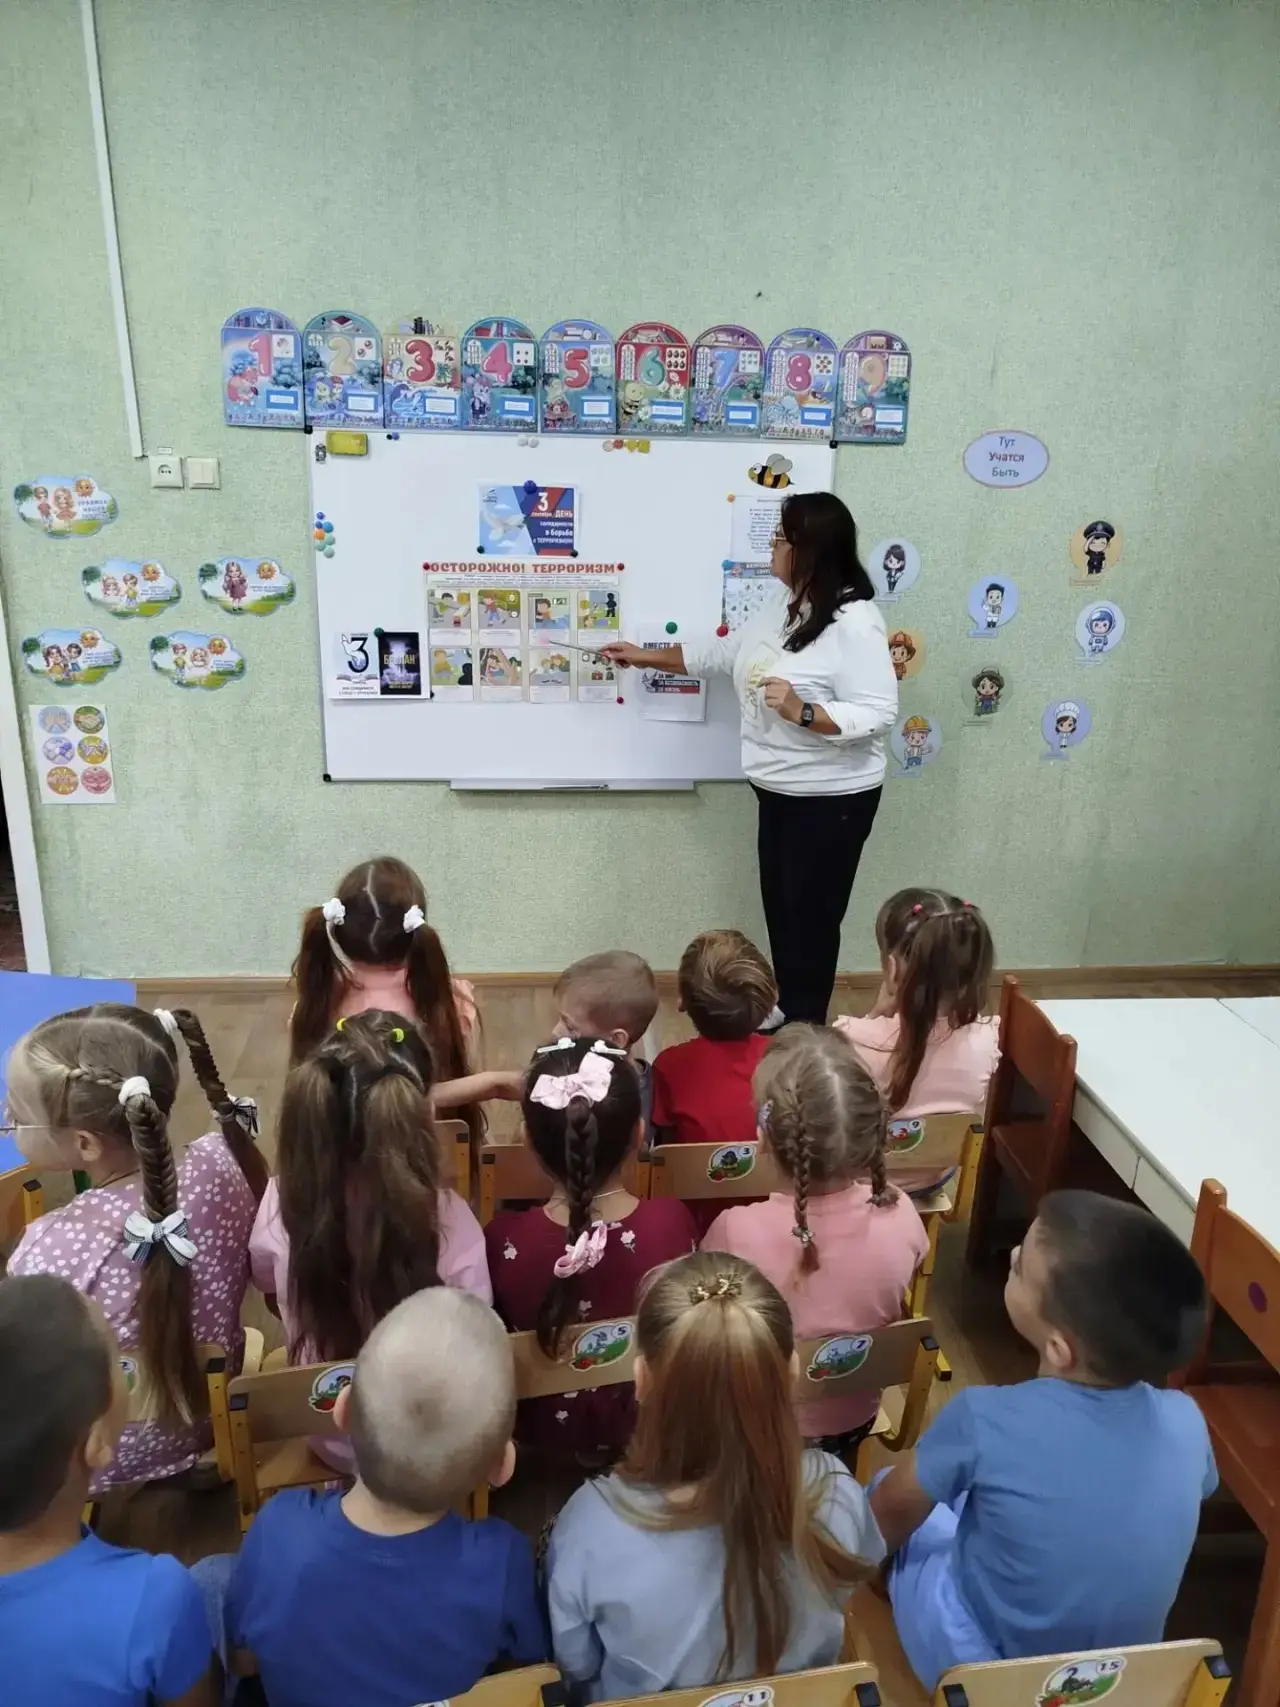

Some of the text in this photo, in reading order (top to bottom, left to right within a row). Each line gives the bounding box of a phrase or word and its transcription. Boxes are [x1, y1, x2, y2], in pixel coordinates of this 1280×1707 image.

[248, 332, 272, 377] 1
[327, 334, 356, 376] 2
[405, 339, 435, 382] 3
[480, 340, 513, 385] 4
[563, 347, 591, 390] 5
[639, 346, 666, 387] 6
[713, 348, 738, 390] 7
[785, 353, 812, 392] 8
[859, 354, 887, 396] 9
[999, 435, 1016, 449] Тут
[988, 451, 1025, 463] Учатся
[992, 466, 1020, 478] Быть
[537, 491, 549, 511] 3
[555, 509, 573, 518] ДЕНЬ
[550, 529, 573, 537] борьбе
[430, 562, 615, 574] ОСТОРОЖНО! ТЕРРОРИЗМ
[347, 636, 369, 673] 3
[742, 1147, 750, 1155] 3
[618, 1326, 627, 1335] 5
[856, 1340, 866, 1349] 7
[1100, 1661, 1120, 1671] 15
[748, 1691, 766, 1702] 11
